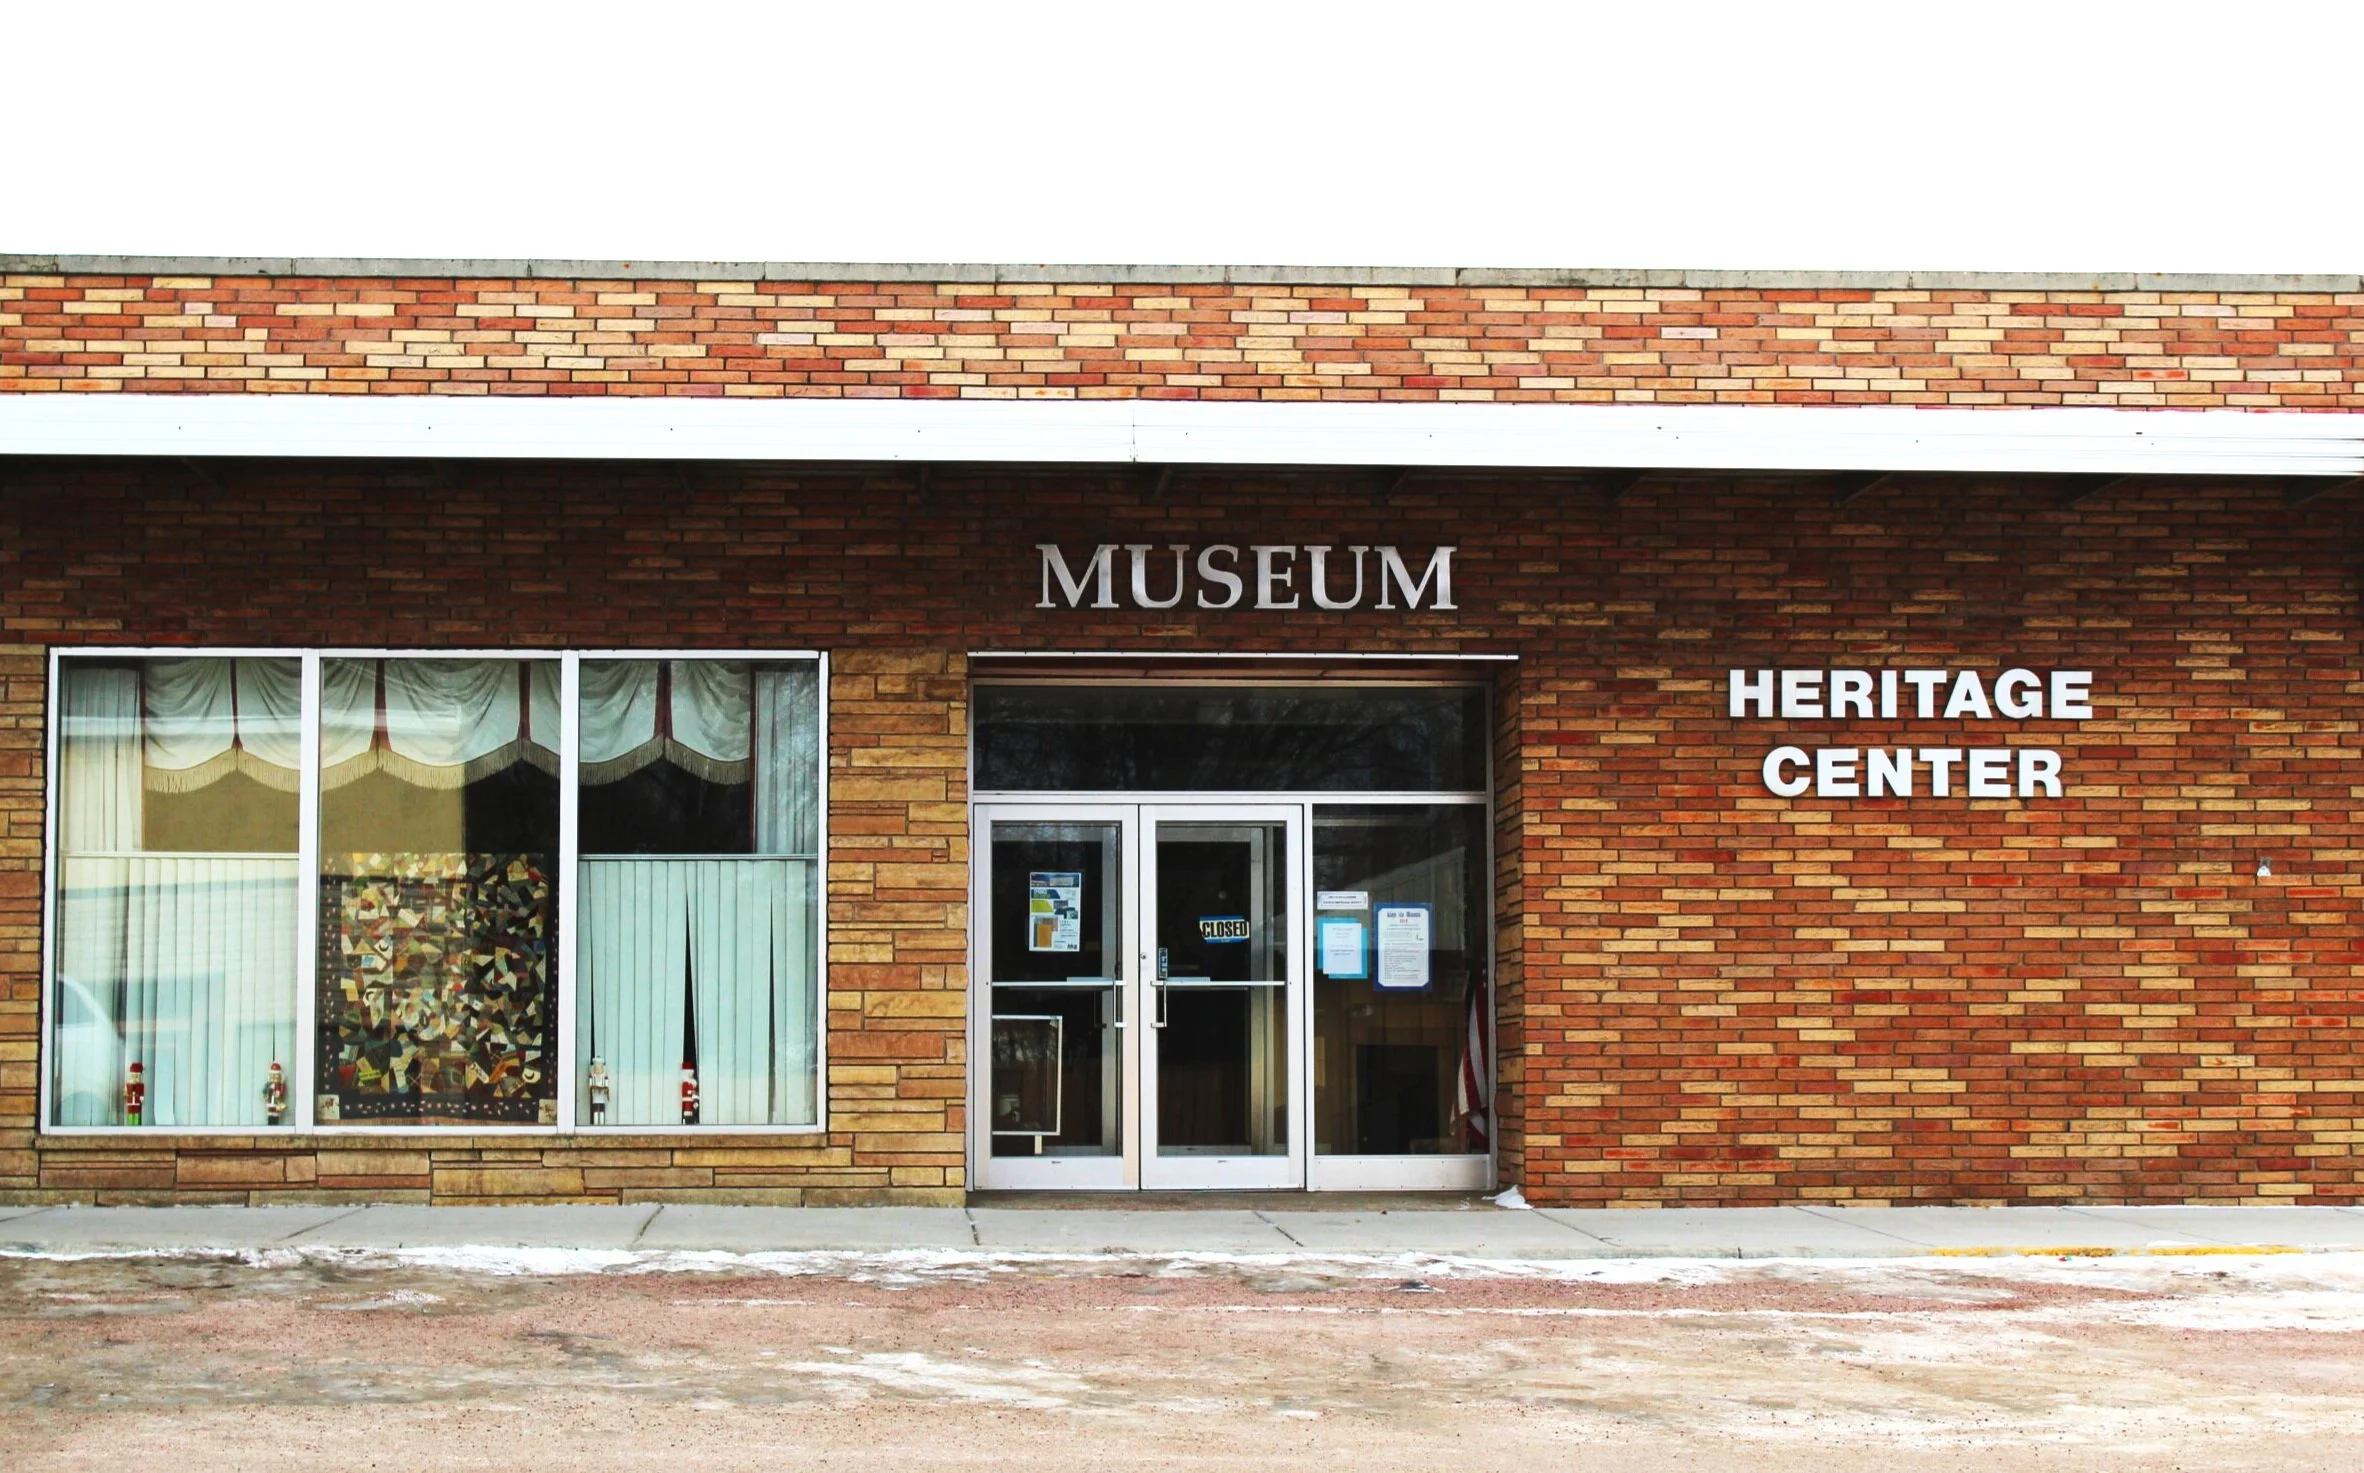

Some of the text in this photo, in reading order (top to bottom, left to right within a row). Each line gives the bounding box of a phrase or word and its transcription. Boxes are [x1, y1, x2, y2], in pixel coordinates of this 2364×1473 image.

[1035, 544, 1458, 609] MUSEUM
[1729, 668, 2093, 720] HERITAGE
[1762, 746, 2063, 798] CENTER
[1202, 921, 1248, 938] CLOSED
